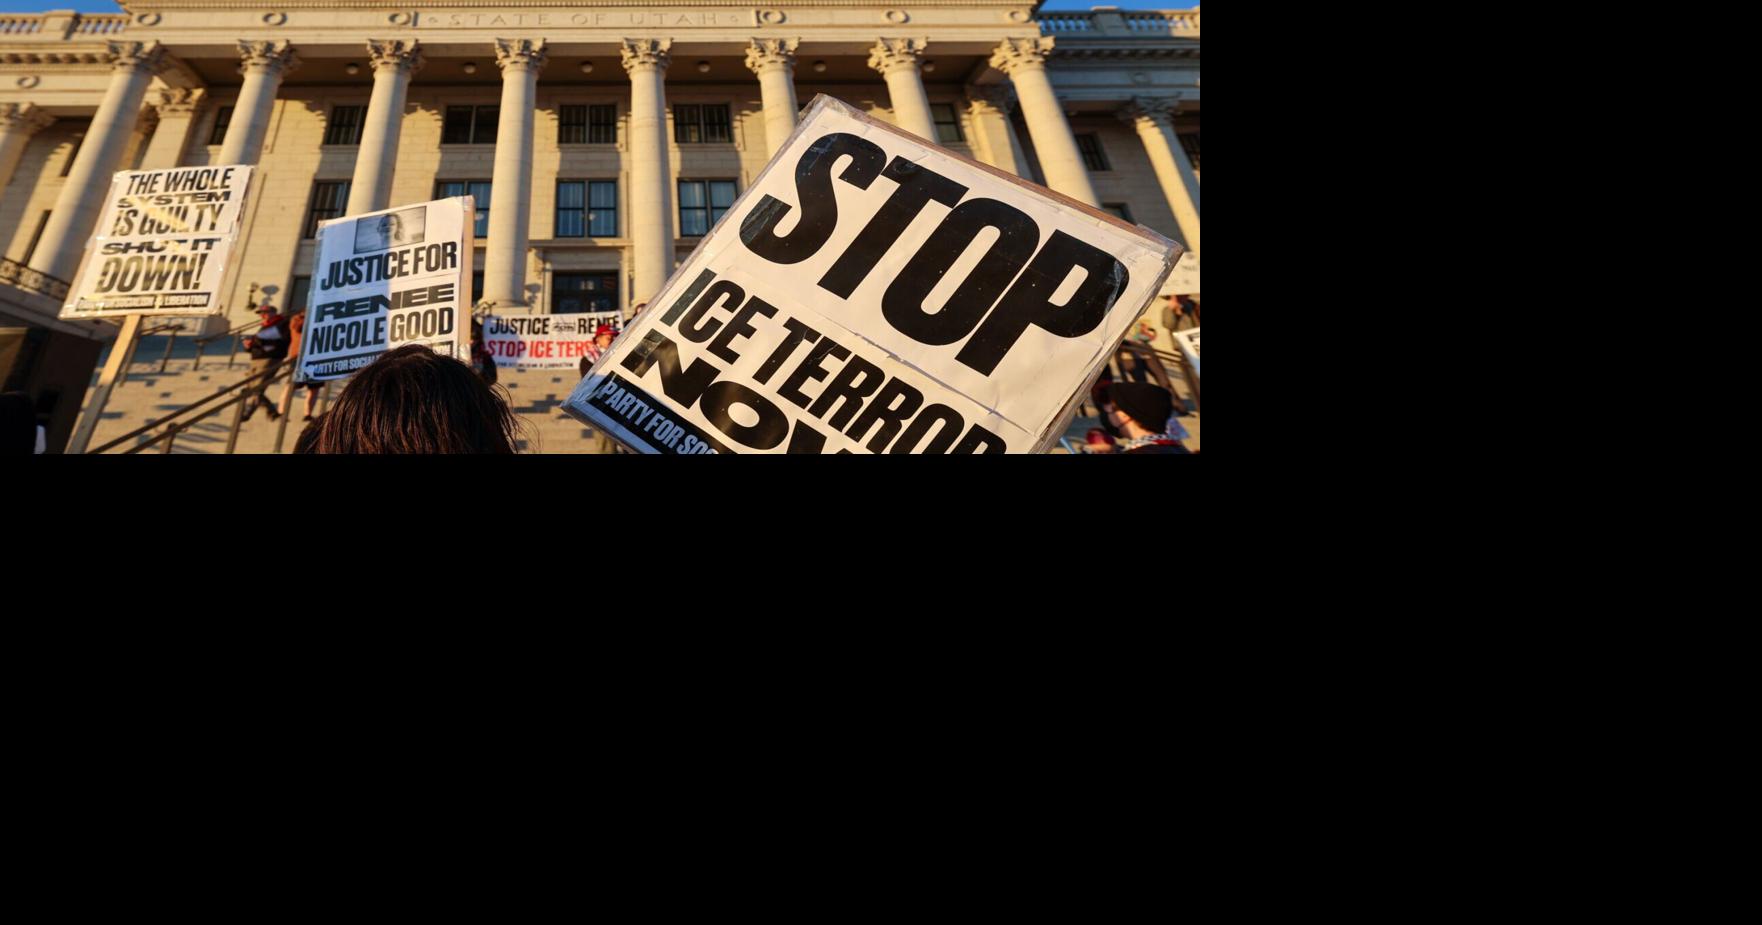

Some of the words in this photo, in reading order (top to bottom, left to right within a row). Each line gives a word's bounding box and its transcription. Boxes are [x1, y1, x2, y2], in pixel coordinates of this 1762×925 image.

[449, 13, 551, 26] STATE
[571, 13, 606, 25] OF
[629, 13, 717, 25] UTAH
[127, 173, 162, 195] THE
[163, 167, 235, 192] WHOLE
[117, 190, 231, 208] SYSTEM
[110, 208, 138, 236] IS
[138, 203, 225, 235] GUILTY
[100, 239, 188, 255] SHUT
[190, 237, 222, 251] IT
[739, 132, 1130, 377] STOP
[95, 253, 208, 293] DOWN!
[321, 249, 410, 290] JUSTICE
[412, 241, 458, 275] FOR
[314, 283, 454, 323] RENEE
[660, 268, 779, 366] ICE
[309, 316, 386, 355] NICOLE
[390, 307, 454, 342] GOOD
[489, 317, 551, 335] JUSTICE
[487, 340, 527, 357] STOP
[528, 341, 554, 358] ICE
[313, 361, 335, 374] ARTY
[333, 359, 349, 372] FOR
[597, 381, 655, 426] PARTY
[643, 412, 686, 449] FOR
